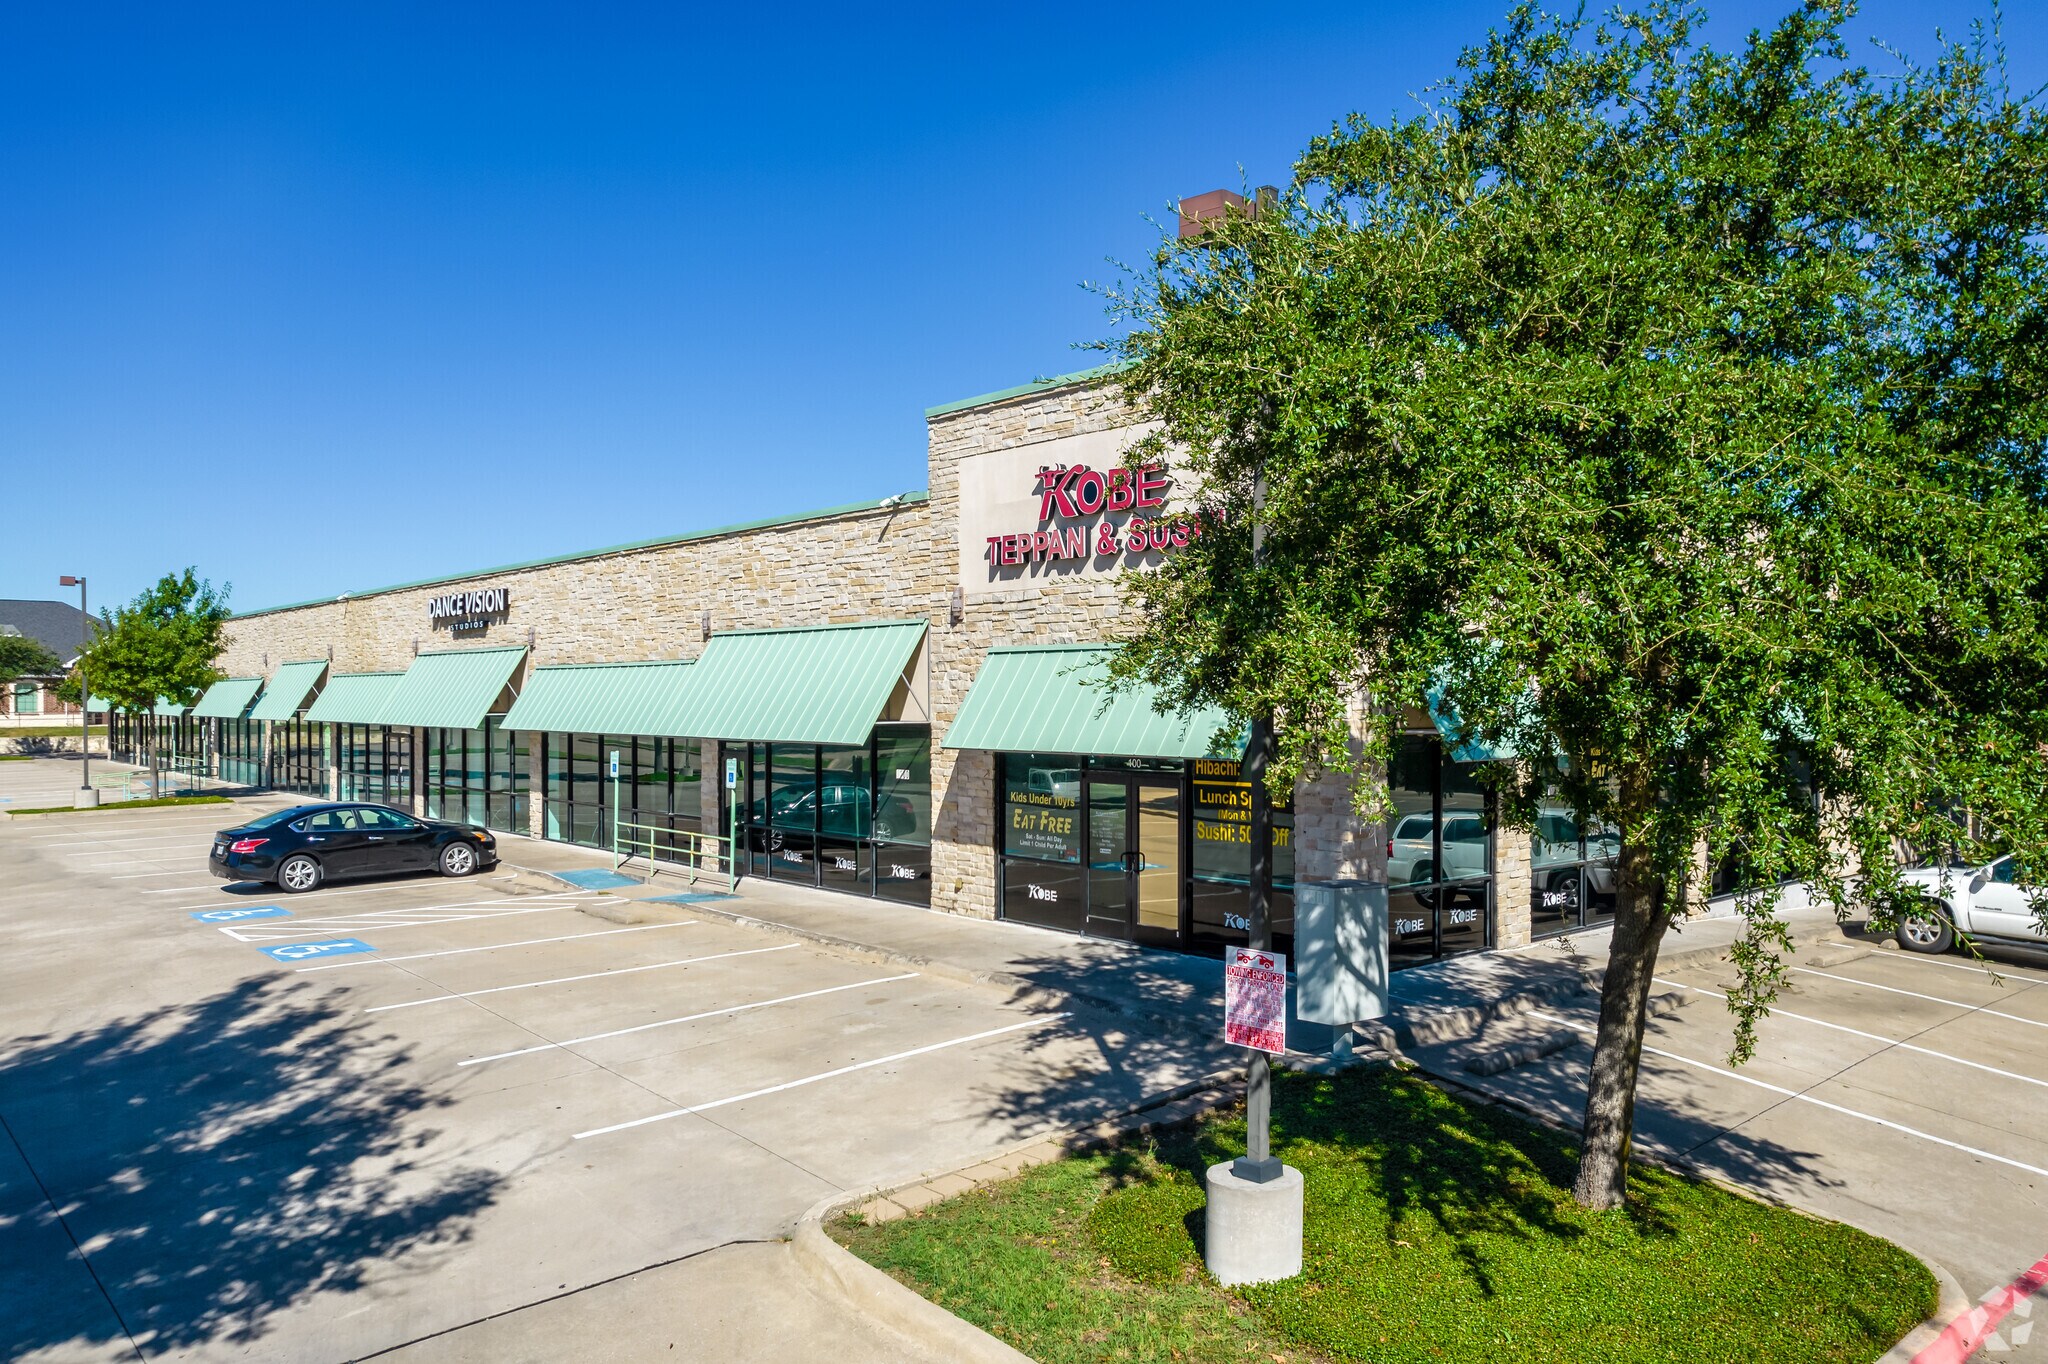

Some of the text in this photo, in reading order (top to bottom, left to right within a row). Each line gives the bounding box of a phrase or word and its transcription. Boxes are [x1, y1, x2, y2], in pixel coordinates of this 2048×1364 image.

[1034, 463, 1170, 521] KOBE
[987, 525, 1087, 566] TEPPAN
[1097, 521, 1118, 555] &
[428, 589, 504, 619] DANCE VISION
[451, 620, 484, 631] STUDIOS
[1195, 759, 1241, 776] Hibachi:
[1010, 791, 1075, 808] Kids Under 10yrs
[1199, 789, 1237, 805] Lunch
[1013, 808, 1037, 830] EAT
[1040, 811, 1072, 834] FREE
[1240, 810, 1247, 821] &
[1197, 821, 1235, 842] Sushi:
[783, 848, 803, 863] KOBE
[835, 856, 857, 871] KOBE
[891, 864, 916, 879] KOBE
[1028, 883, 1058, 902] KOBE
[1542, 891, 1568, 907] KOBE
[1449, 908, 1478, 925] KOBE
[1394, 918, 1425, 935] KOBE
[1227, 965, 1284, 984] TOWING ENFORCED
[1248, 979, 1268, 989] PARKING
[1270, 983, 1283, 992] ONLY
